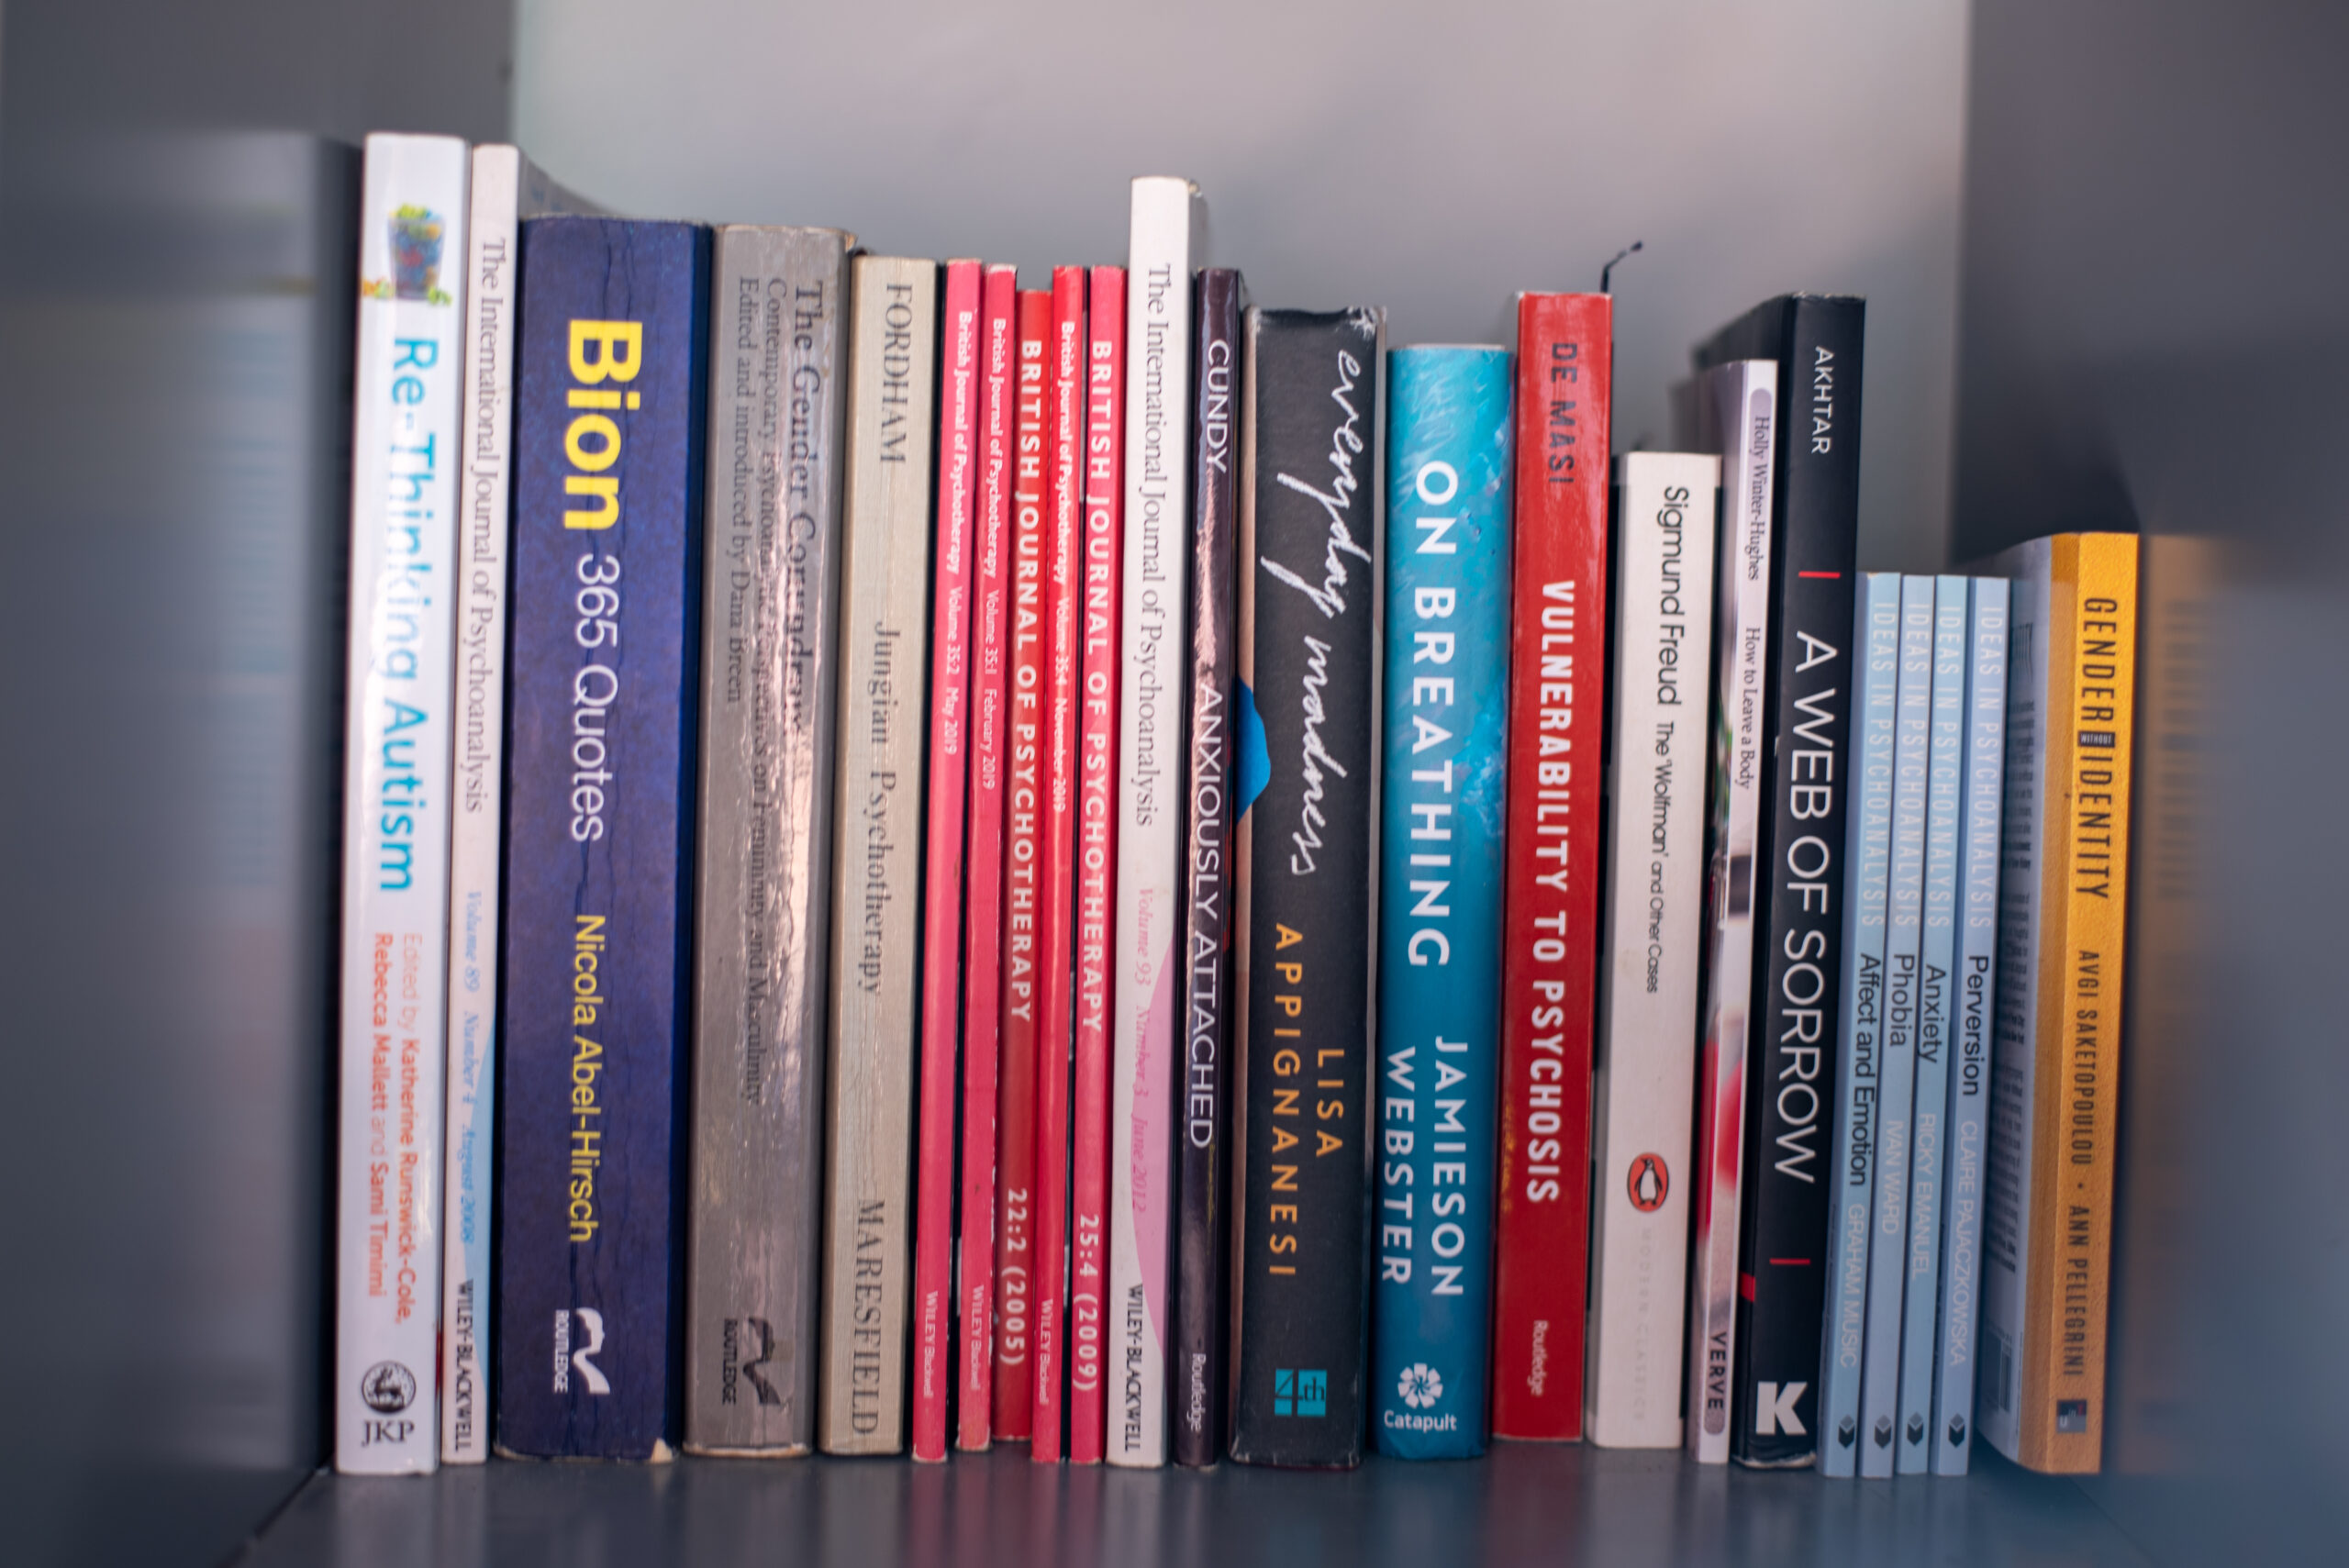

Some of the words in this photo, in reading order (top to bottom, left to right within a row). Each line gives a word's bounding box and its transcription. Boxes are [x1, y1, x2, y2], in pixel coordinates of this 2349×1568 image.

[481, 238, 507, 289] The
[1147, 264, 1171, 314] The
[737, 277, 760, 350] Edited
[794, 280, 823, 350] The
[956, 311, 973, 367] British
[990, 318, 1007, 373] British
[1060, 321, 1075, 377] British
[476, 296, 504, 462] International
[736, 358, 756, 397] and
[758, 277, 787, 442] Contemporary
[880, 283, 913, 464] FORDHAM
[1552, 342, 1577, 384] DE
[563, 319, 642, 530] Bion
[789, 366, 820, 499] Gender
[954, 370, 971, 431] Journal
[988, 376, 1005, 437] Journal
[1020, 339, 1041, 477] BRITISH
[1057, 380, 1074, 441] Journal
[1091, 339, 1112, 479] BRITISH
[1143, 322, 1169, 484] International
[1207, 339, 1229, 473] CUNDY
[1748, 416, 1770, 459] Holly
[1811, 346, 1833, 454] AKHTAR
[732, 406, 755, 527] introduced
[955, 434, 969, 452] of
[990, 440, 1004, 457] of
[1059, 444, 1073, 463] of
[1548, 400, 1575, 484] MASI
[371, 337, 440, 680] Re-Thinking
[470, 465, 500, 562] Journal
[947, 454, 967, 574] Psychotherapy
[983, 459, 1002, 579] Psychotherapy
[1261, 350, 1371, 618] everyday
[1415, 462, 1458, 554] ON
[1745, 463, 1768, 581] Winter-Hughes
[727, 535, 752, 562] by
[1053, 465, 1072, 585] Psychotherapy
[1139, 487, 1165, 582] Journal
[1657, 486, 1689, 615] Sigmund
[473, 571, 497, 599] of
[575, 553, 620, 648] 365
[729, 572, 751, 629] Dana
[1016, 493, 1040, 651] JOURNAL
[1086, 494, 1110, 654] JOURNAL
[1141, 590, 1164, 615] of
[727, 638, 748, 704] Breen
[1657, 624, 1685, 706] Freud
[1743, 668, 1758, 684] to
[1744, 627, 1761, 664] How
[1795, 631, 1837, 673] A
[1871, 602, 1895, 672] IDEAS
[1905, 603, 1930, 672] IDEAS
[1937, 606, 1961, 674] IDEAS
[1979, 606, 2002, 675] IDEAS
[2081, 598, 2118, 721] GENDER
[460, 606, 495, 814] Psychoanalysis
[867, 622, 901, 744] Jungian
[942, 687, 959, 717] May
[979, 688, 997, 752] February
[1017, 665, 1037, 709] OF
[1087, 672, 1108, 717] OF
[1741, 688, 1758, 733] Leave
[1870, 684, 1893, 706] IN
[1904, 685, 1928, 707] IN
[1936, 687, 1959, 708] IN
[1978, 688, 1999, 709] IN
[572, 664, 618, 842] Quotes
[944, 720, 958, 755] 2019
[1052, 697, 1068, 775] November
[1131, 625, 1163, 826] Psychoanalysis
[1291, 636, 1347, 875] madness
[1535, 580, 1575, 892] VULNERABILITY
[1653, 722, 1675, 755] The
[1740, 737, 1753, 746] a
[1789, 688, 1835, 819] WEB
[2080, 733, 2112, 745] WITHOUT
[379, 698, 429, 893] Autism
[982, 755, 996, 789] 2019
[1195, 683, 1222, 920] ANXIOUSLY
[1408, 587, 1455, 966] BREATHING
[1734, 750, 1755, 790] Body
[1862, 719, 1890, 926] PSYCHOANALYSIS
[1895, 720, 1925, 926] PSYCHOANALYSIS
[1927, 723, 1958, 927] PSYCHOANALYSIS
[1969, 724, 1999, 928] PSYCHOANALYSIS
[2076, 755, 2114, 899] IDENTITY
[858, 771, 896, 995] Psychotherapy
[1010, 723, 1035, 1022] PSYCHOTHERAPY
[1083, 732, 1106, 1032] PSYCHOTHERAPY
[1651, 862, 1664, 893] and
[1787, 836, 1830, 915] OF
[1137, 888, 1153, 957] Volume
[1532, 911, 1566, 962] TO
[1648, 898, 1664, 940] Other
[372, 933, 395, 1027] Rebecca
[400, 933, 423, 1001] Edited
[573, 915, 606, 1026] Nicola
[1135, 959, 1152, 986] 93
[1647, 944, 1663, 994] Cases
[1856, 953, 1881, 1024] Affect
[1889, 953, 1916, 1047] Phobia
[2076, 950, 2099, 998] AVGI
[398, 1006, 420, 1032] by
[1133, 1006, 1152, 1084] Number
[1190, 930, 1217, 1149] ATTACHED
[1916, 964, 1946, 1062] Anxiety
[1962, 955, 1989, 1095] Perversion
[371, 1033, 391, 1111] Mallett
[397, 1038, 421, 1145] Katherine
[1527, 980, 1564, 1202] PSYCHOSIS
[1775, 929, 1826, 1183] SORROW
[1854, 1032, 1874, 1078] and
[2070, 1009, 2098, 1165] SAKETOPOULOU
[370, 1116, 390, 1157] and
[569, 1034, 604, 1242] Abel-Hirsch
[1269, 923, 1302, 1275] APPIGNANESI
[1316, 1049, 1344, 1157] LISA
[1850, 1086, 1875, 1186] Emotion
[1382, 1046, 1416, 1284] WEBSTER
[1431, 1037, 1468, 1296] JAMIESON
[1885, 1120, 1904, 1165] IVAN
[1915, 1113, 1936, 1174] RICKY
[1956, 1122, 1977, 1193] CLAIRE
[369, 1162, 390, 1215] Sami
[1007, 1188, 1028, 1252] 22:2
[1131, 1164, 1147, 1213] 2012
[1882, 1173, 1902, 1234] WARD
[2066, 1205, 2090, 1247] ANN
[368, 1221, 387, 1297] Timimi
[395, 1151, 419, 1325] Runswick-Cole,
[1078, 1214, 1098, 1277] 25:4
[1842, 1204, 1865, 1294] GRAHAM
[1911, 1181, 1934, 1280] EMANUEL
[852, 1198, 885, 1435] MARESFIELD
[1000, 1265, 1027, 1365] (2005)
[1949, 1199, 1975, 1365] PAJACZKOWSKA
[2063, 1258, 2088, 1376] PELLEGRINI
[454, 1278, 474, 1452] WILEY-BLACKWELL
[554, 1310, 570, 1394] ROUTLEDGE
[723, 1318, 738, 1406] ROUTLEDGE
[1073, 1293, 1097, 1391] (2009)
[1124, 1283, 1143, 1452] WILEY-BLACKWELL
[1527, 1320, 1549, 1396] Routledge
[1708, 1331, 1727, 1410] VERVE
[1840, 1300, 1862, 1368] MUSIC
[1186, 1353, 1206, 1431] Routledge
[1384, 1410, 1457, 1433] Catapult
[1756, 1381, 1808, 1435] K
[361, 1418, 415, 1448] JKP
